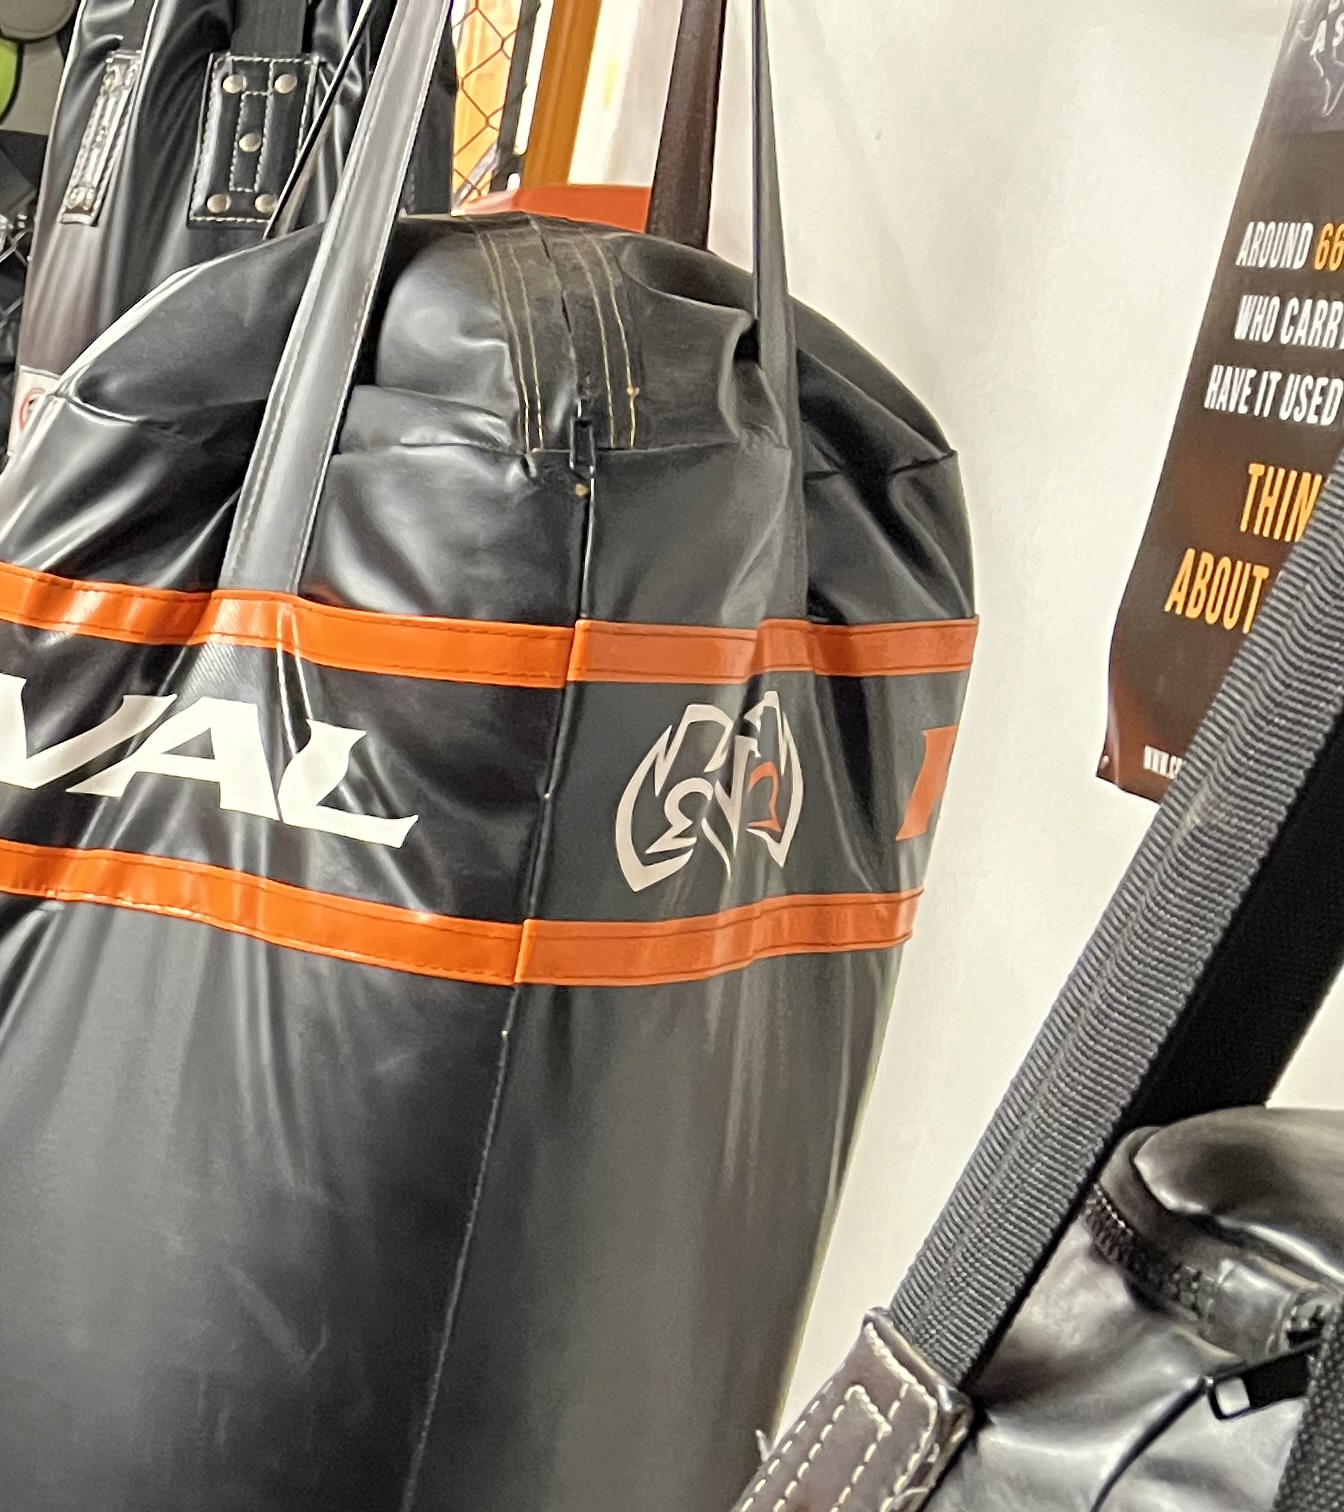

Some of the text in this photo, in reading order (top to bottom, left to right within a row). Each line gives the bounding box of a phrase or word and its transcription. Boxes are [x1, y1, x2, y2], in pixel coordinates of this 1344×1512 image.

[1235, 221, 1314, 270] AROUND
[1234, 295, 1344, 350] WHO CARR
[1204, 365, 1344, 426] HAVE IT USED
[1240, 463, 1324, 543] THIN
[1164, 548, 1270, 634] ABOUT
